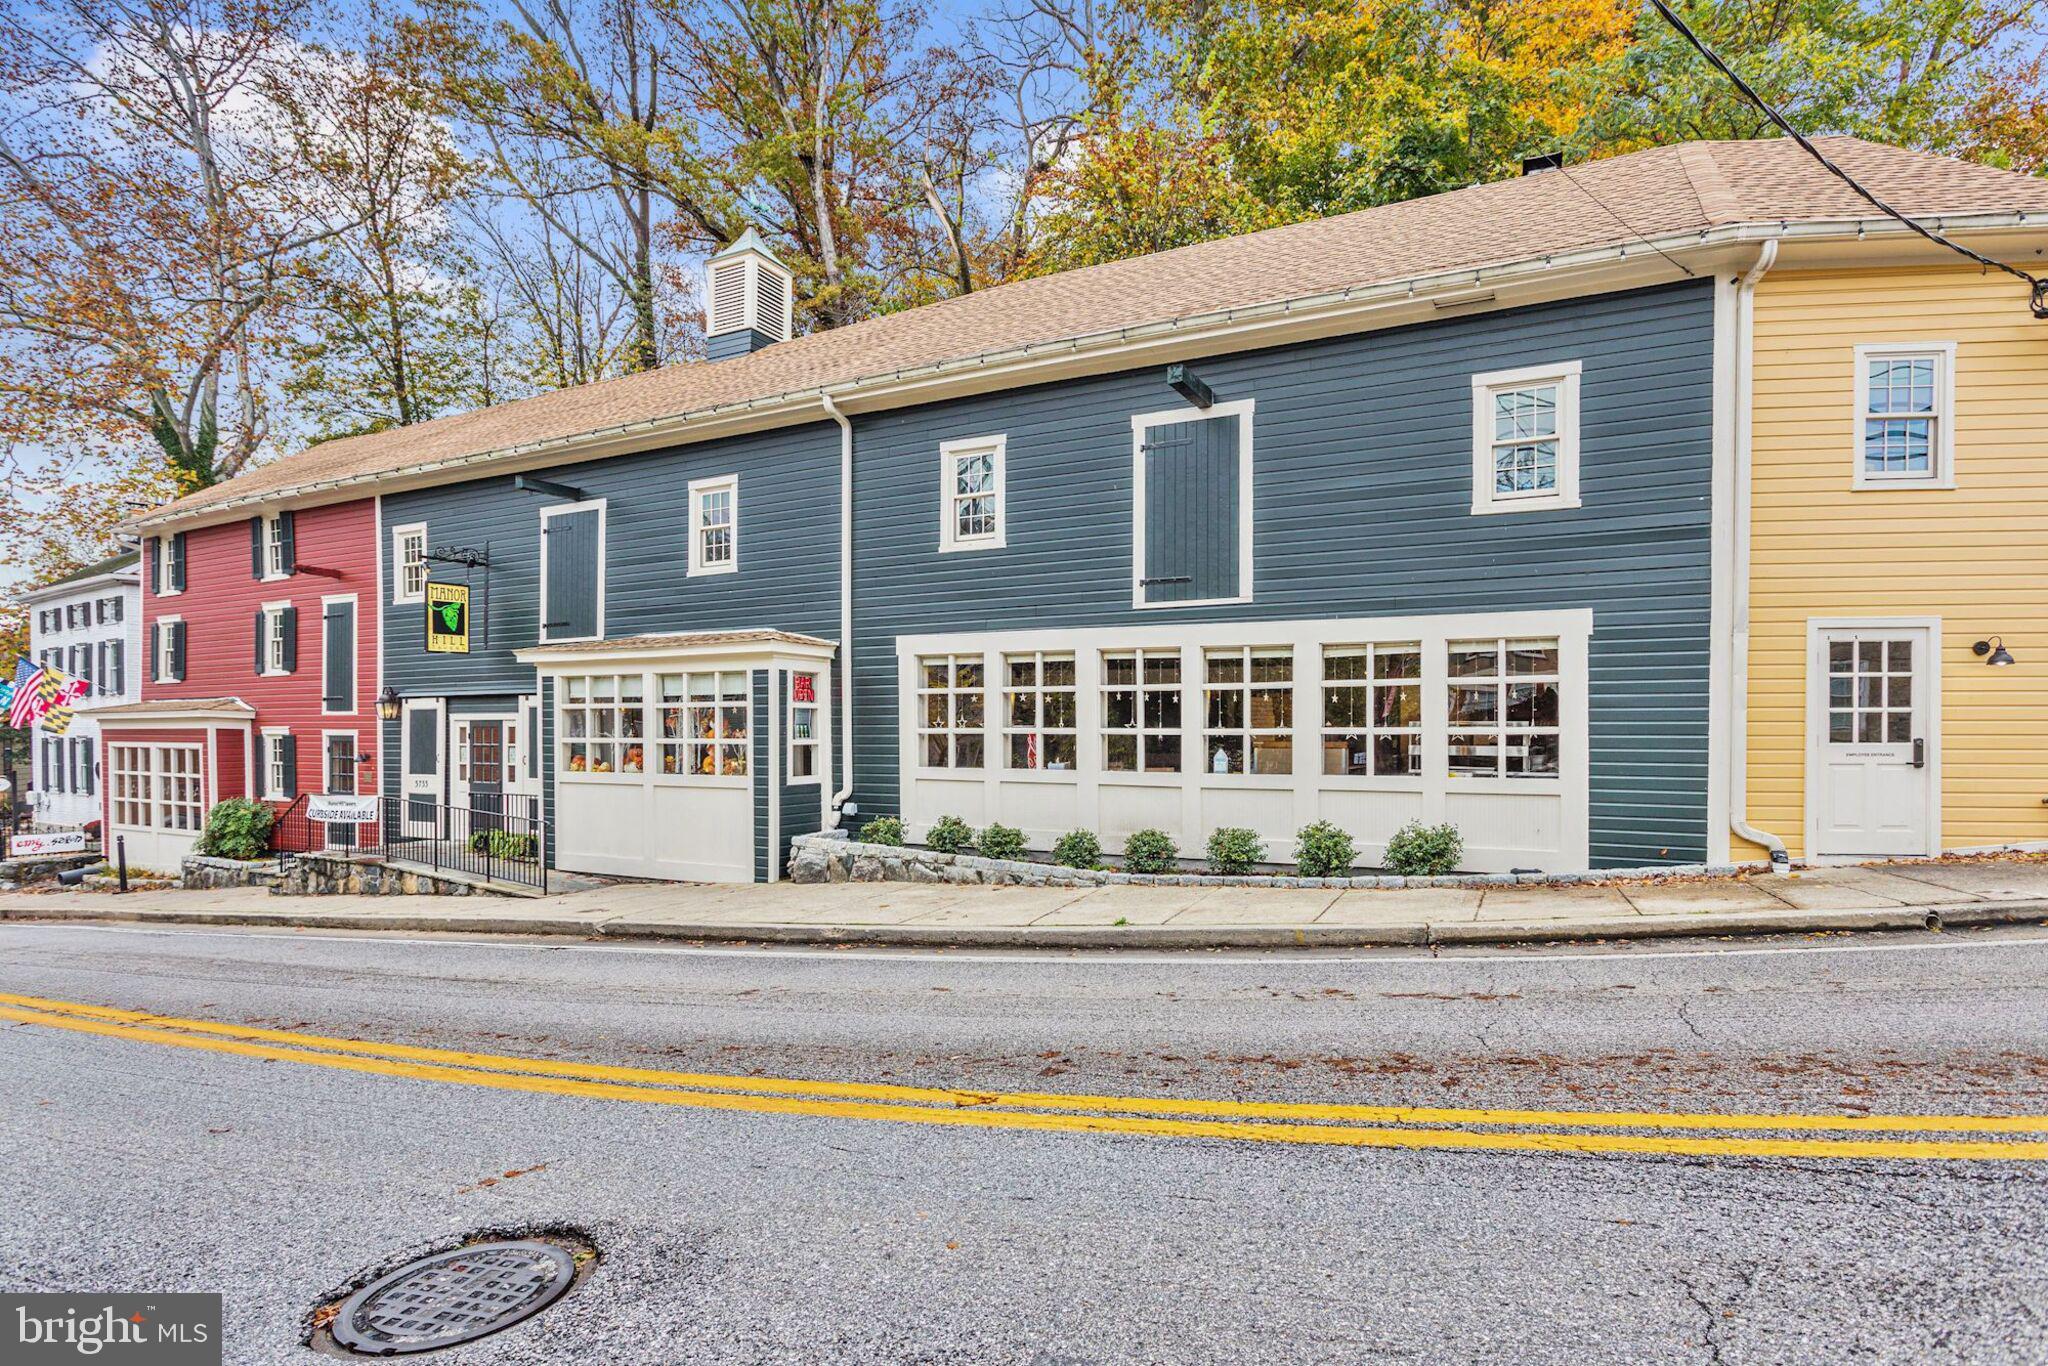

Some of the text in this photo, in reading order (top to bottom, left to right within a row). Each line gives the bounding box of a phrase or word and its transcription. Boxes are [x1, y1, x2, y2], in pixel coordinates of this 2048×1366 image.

[430, 587, 467, 602] MANOR
[432, 635, 465, 646] HILL
[308, 809, 374, 820] CURBSIDE AVAILABLE
